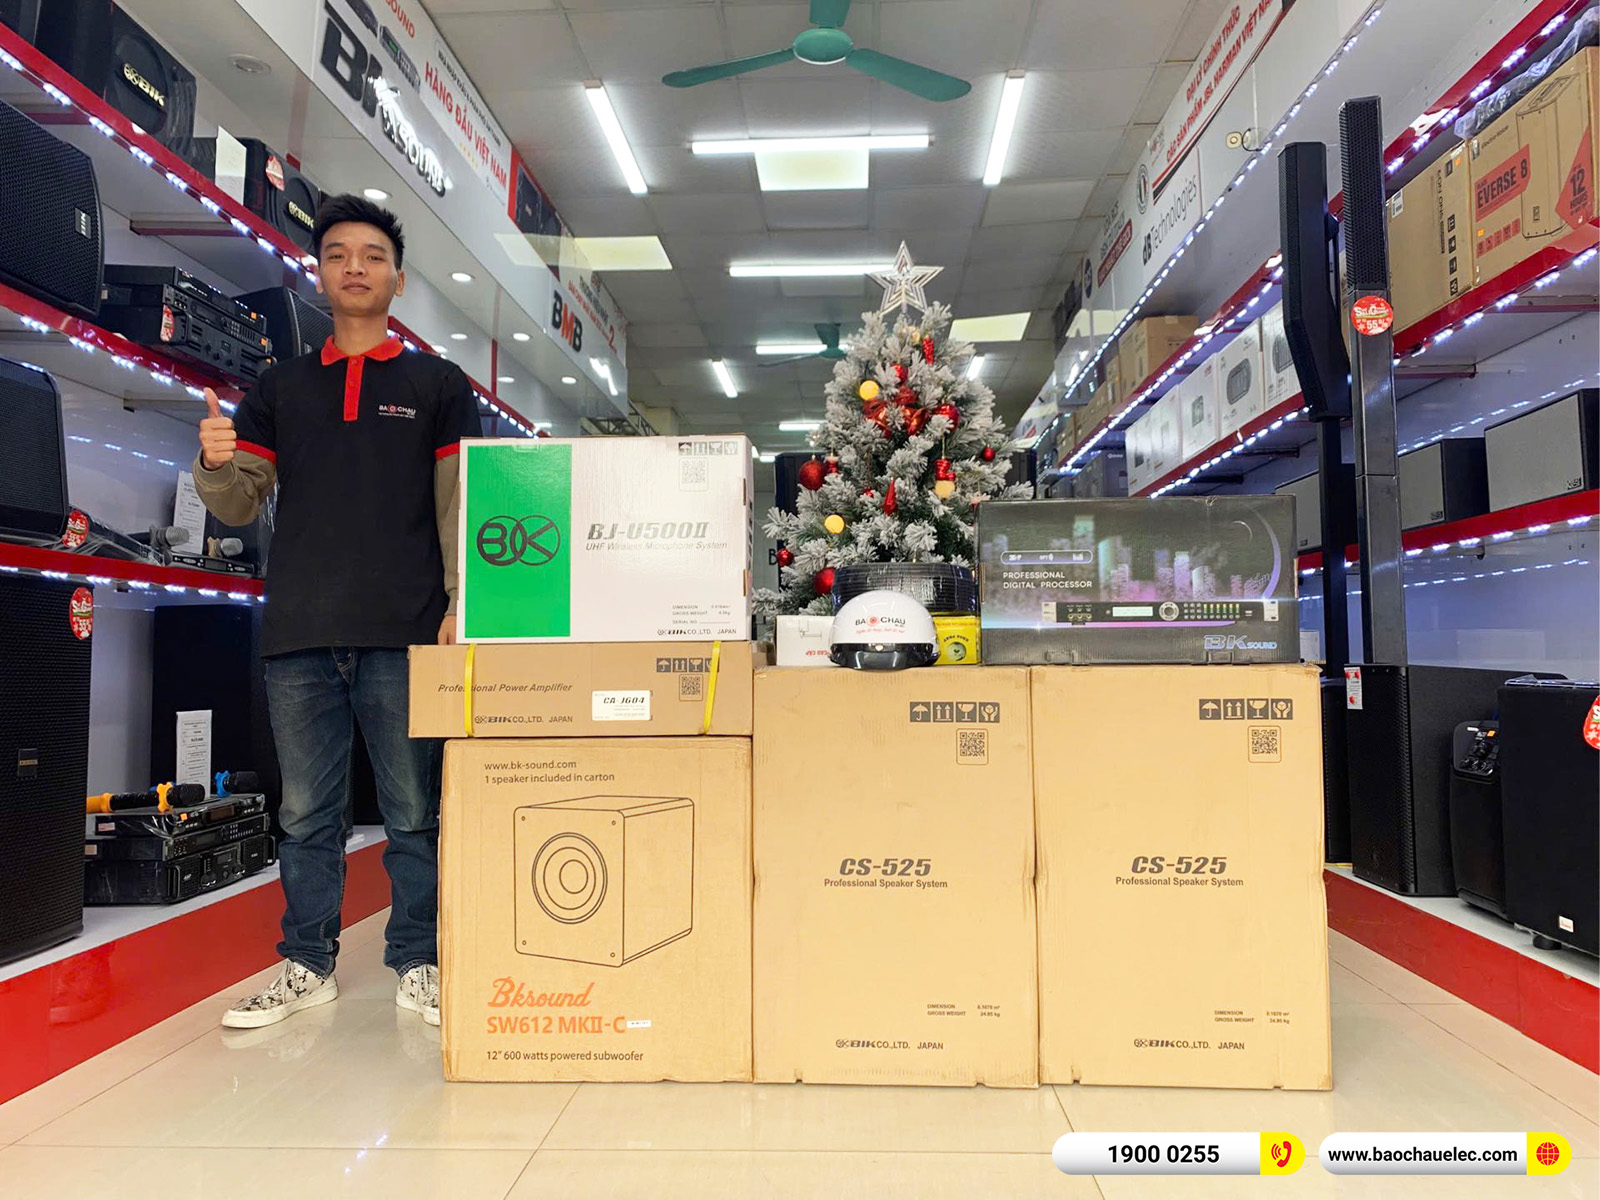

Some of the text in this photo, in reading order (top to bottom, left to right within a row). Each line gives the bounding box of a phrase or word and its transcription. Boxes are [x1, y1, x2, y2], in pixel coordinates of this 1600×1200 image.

[137, 75, 165, 107] BIK
[425, 61, 507, 188] HÀNG ĐẦU VIỆT NAM
[1477, 158, 1528, 209] EVERSE 8
[1570, 168, 1586, 197] 12
[297, 208, 315, 229] BIK
[552, 290, 582, 352] BMB
[586, 541, 727, 552] UHF Wireless Microphone System
[1003, 571, 1065, 579] PROFESSIONAL
[1003, 580, 1092, 589] DIGITAL PROCESSOR
[880, 616, 905, 625] CHAU
[1203, 634, 1278, 650] BK SOUND
[499, 683, 528, 693] Power
[529, 682, 573, 693] Amplifier
[549, 715, 573, 723] JAPAN
[484, 760, 577, 771] www.bk-sound.com
[492, 775, 529, 786] speaker
[530, 773, 572, 783] included
[573, 773, 582, 782] in
[584, 773, 615, 782] carton
[839, 858, 931, 876] CS-525
[1131, 856, 1227, 874] CS-525
[824, 878, 948, 889] Professional Speaker System
[1116, 876, 1244, 887] Professional Speaker System
[488, 977, 595, 1008] Bksound
[487, 1016, 552, 1034] SW612
[917, 1042, 944, 1050] JAPAN
[1217, 1041, 1245, 1050] JAPAN
[504, 1051, 521, 1061] 600
[522, 1051, 548, 1061] watts
[550, 1050, 592, 1062] powered
[593, 1050, 643, 1061] subwoofer
